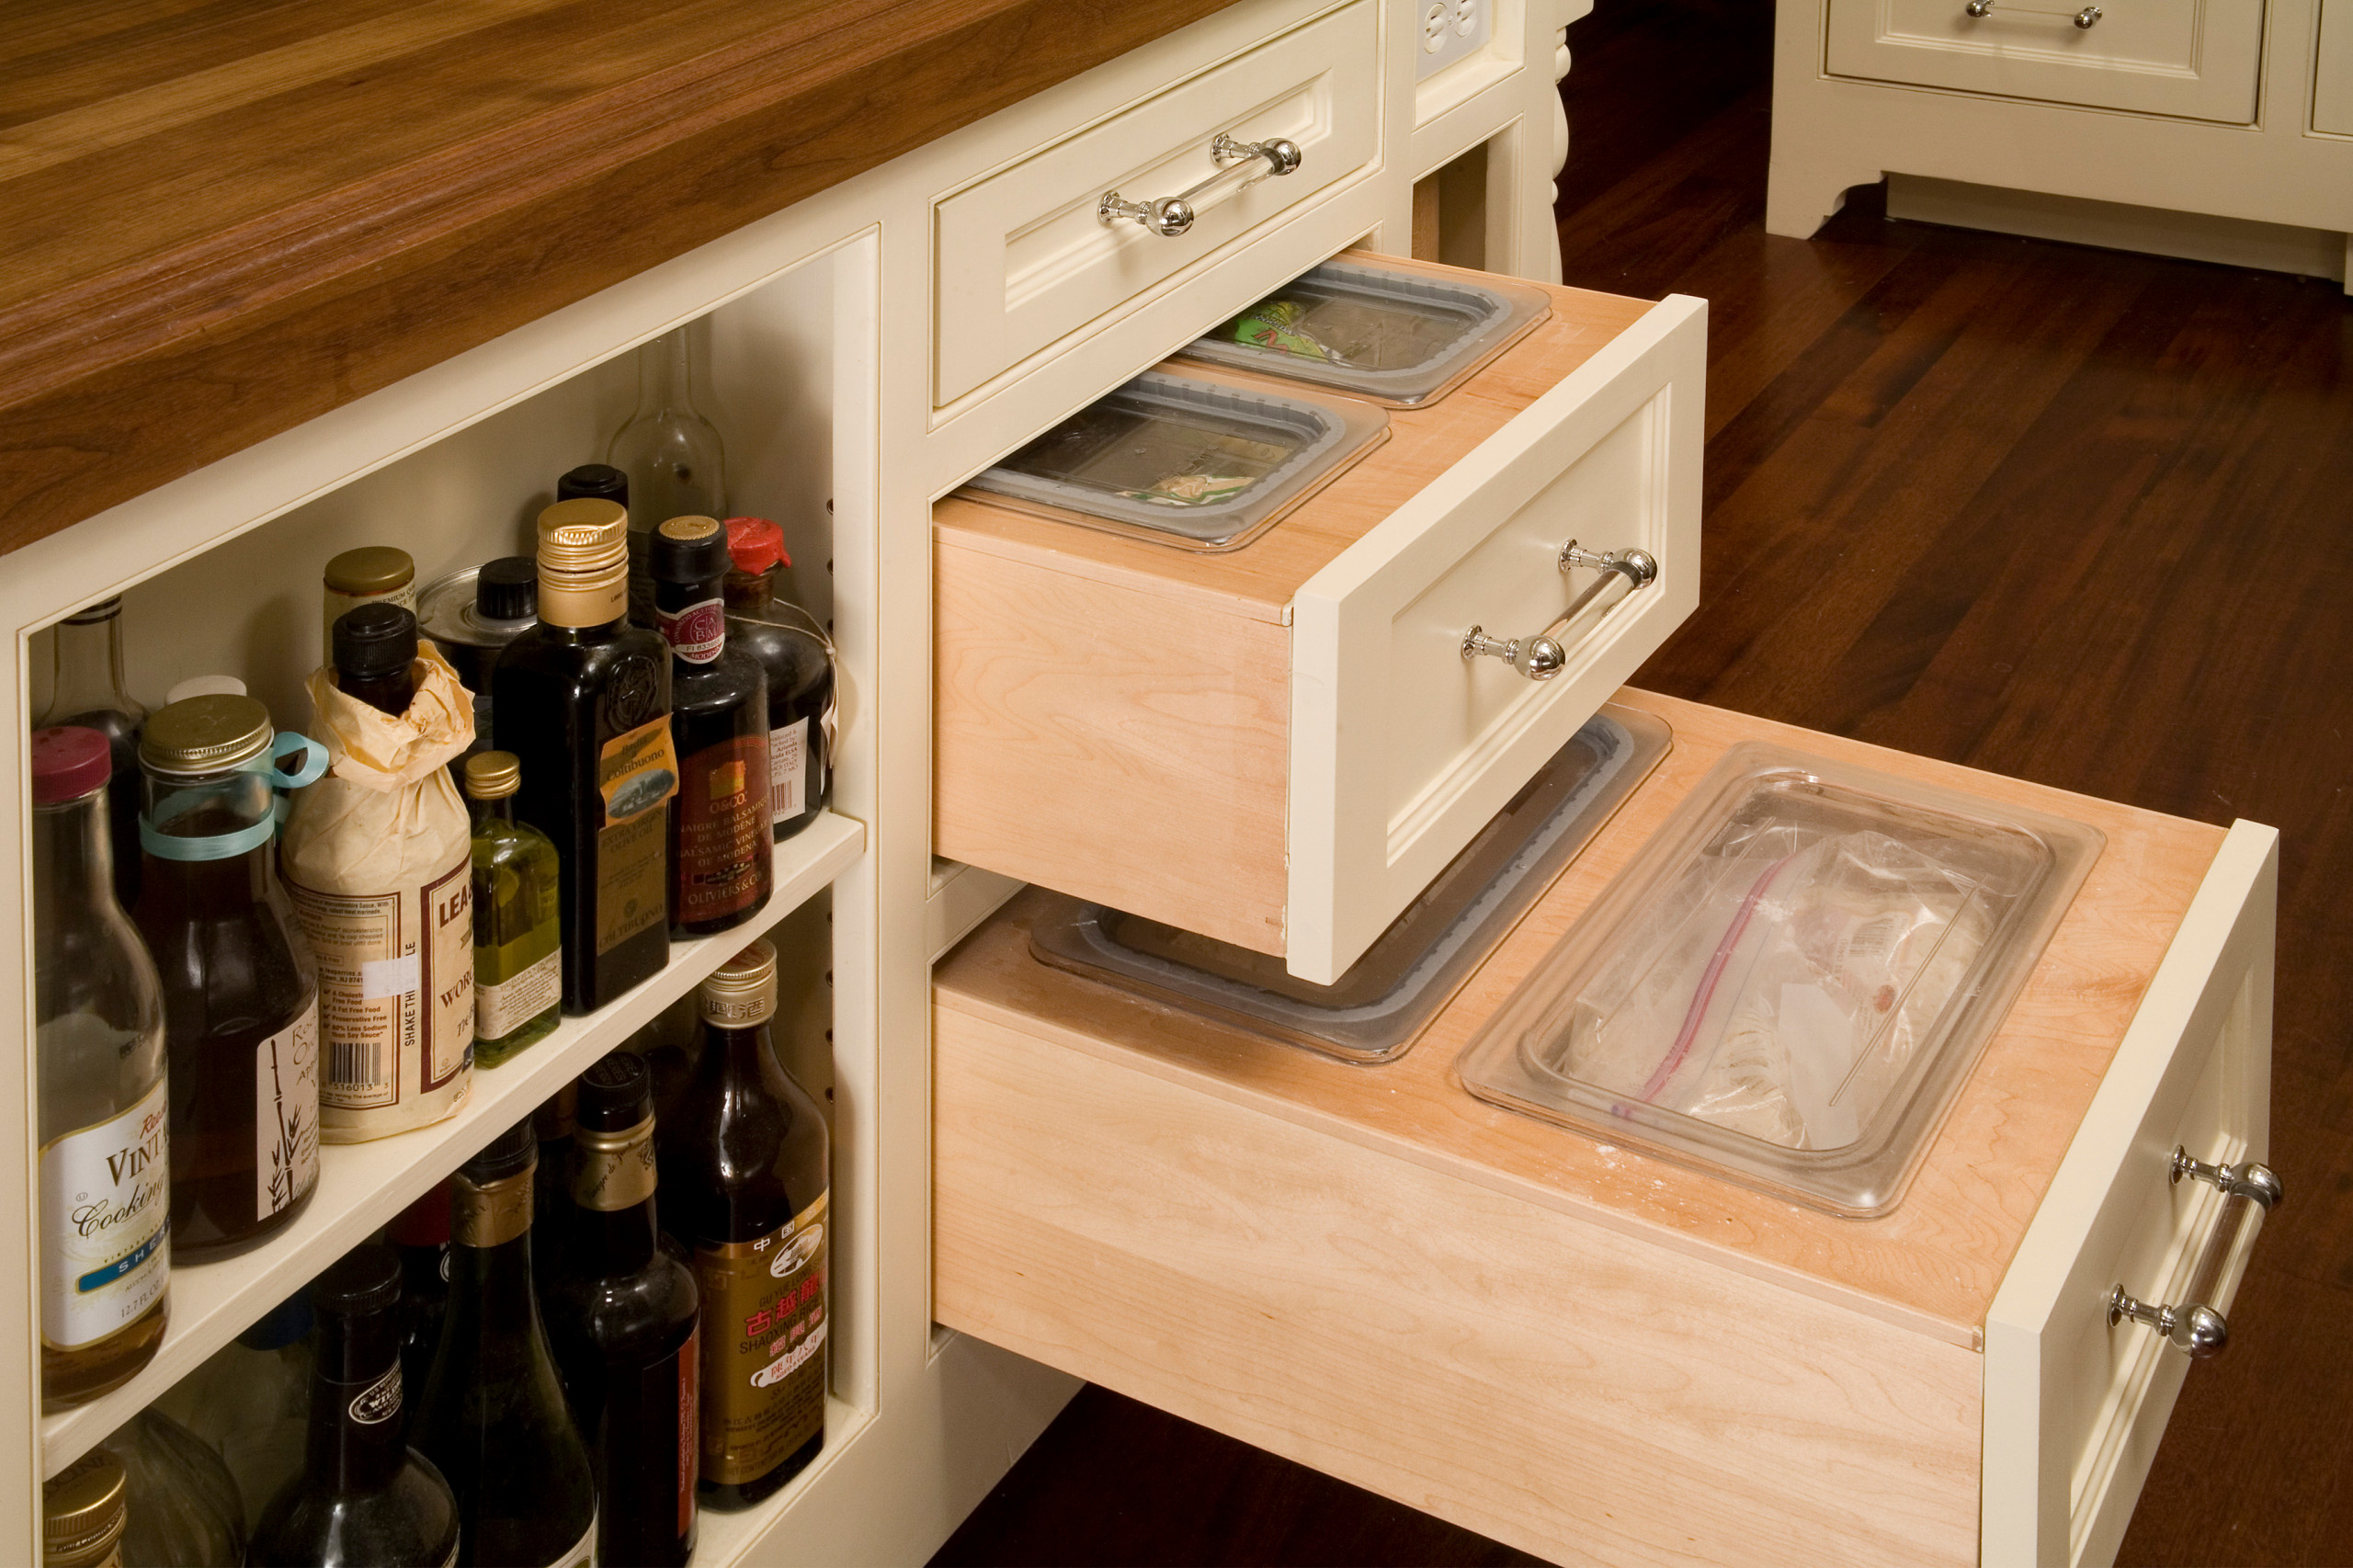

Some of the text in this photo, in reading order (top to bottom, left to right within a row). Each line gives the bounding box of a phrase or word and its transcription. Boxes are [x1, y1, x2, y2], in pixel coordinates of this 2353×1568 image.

[607, 749, 665, 781] Coltibuono
[405, 990, 415, 1047] SHAKE THI
[72, 1175, 165, 1239] Cooking
[758, 1294, 773, 1309] GU
[740, 1313, 797, 1355] SHAOXING
